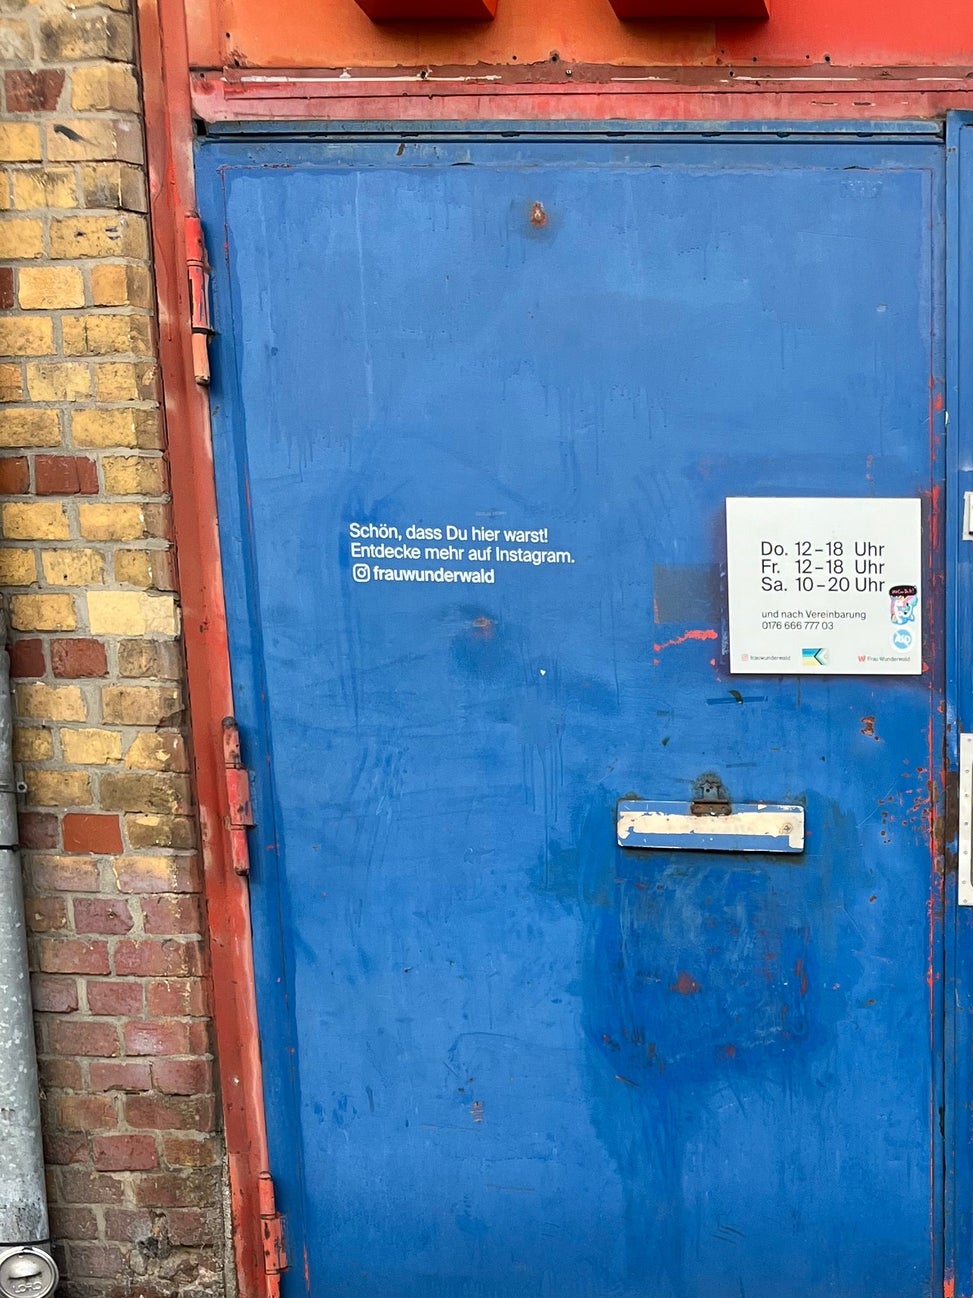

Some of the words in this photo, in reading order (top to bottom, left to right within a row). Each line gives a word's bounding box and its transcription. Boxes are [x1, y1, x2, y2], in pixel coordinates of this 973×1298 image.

[349, 522, 403, 542] Schön,
[405, 524, 442, 541] dass
[446, 525, 468, 541] Du
[471, 526, 500, 542] hier
[503, 527, 549, 543] warst!
[350, 542, 421, 559] Entdecke
[424, 545, 465, 561] mehr
[468, 546, 493, 562] auf
[495, 546, 576, 566] Instagram.
[761, 541, 788, 556] Do.
[854, 541, 885, 556] Uhr
[761, 559, 780, 574] Fr.
[854, 559, 885, 574] Uhr
[373, 565, 495, 584] frauwunderwald
[761, 577, 788, 592] Sa.
[854, 577, 885, 592] Uhr
[761, 610, 779, 619] und
[780, 610, 804, 619] nach
[805, 610, 867, 620] Vereinbarung
[761, 621, 783, 630] 0176
[784, 621, 803, 630] 666
[804, 621, 820, 630] 777
[821, 621, 834, 630] 03
